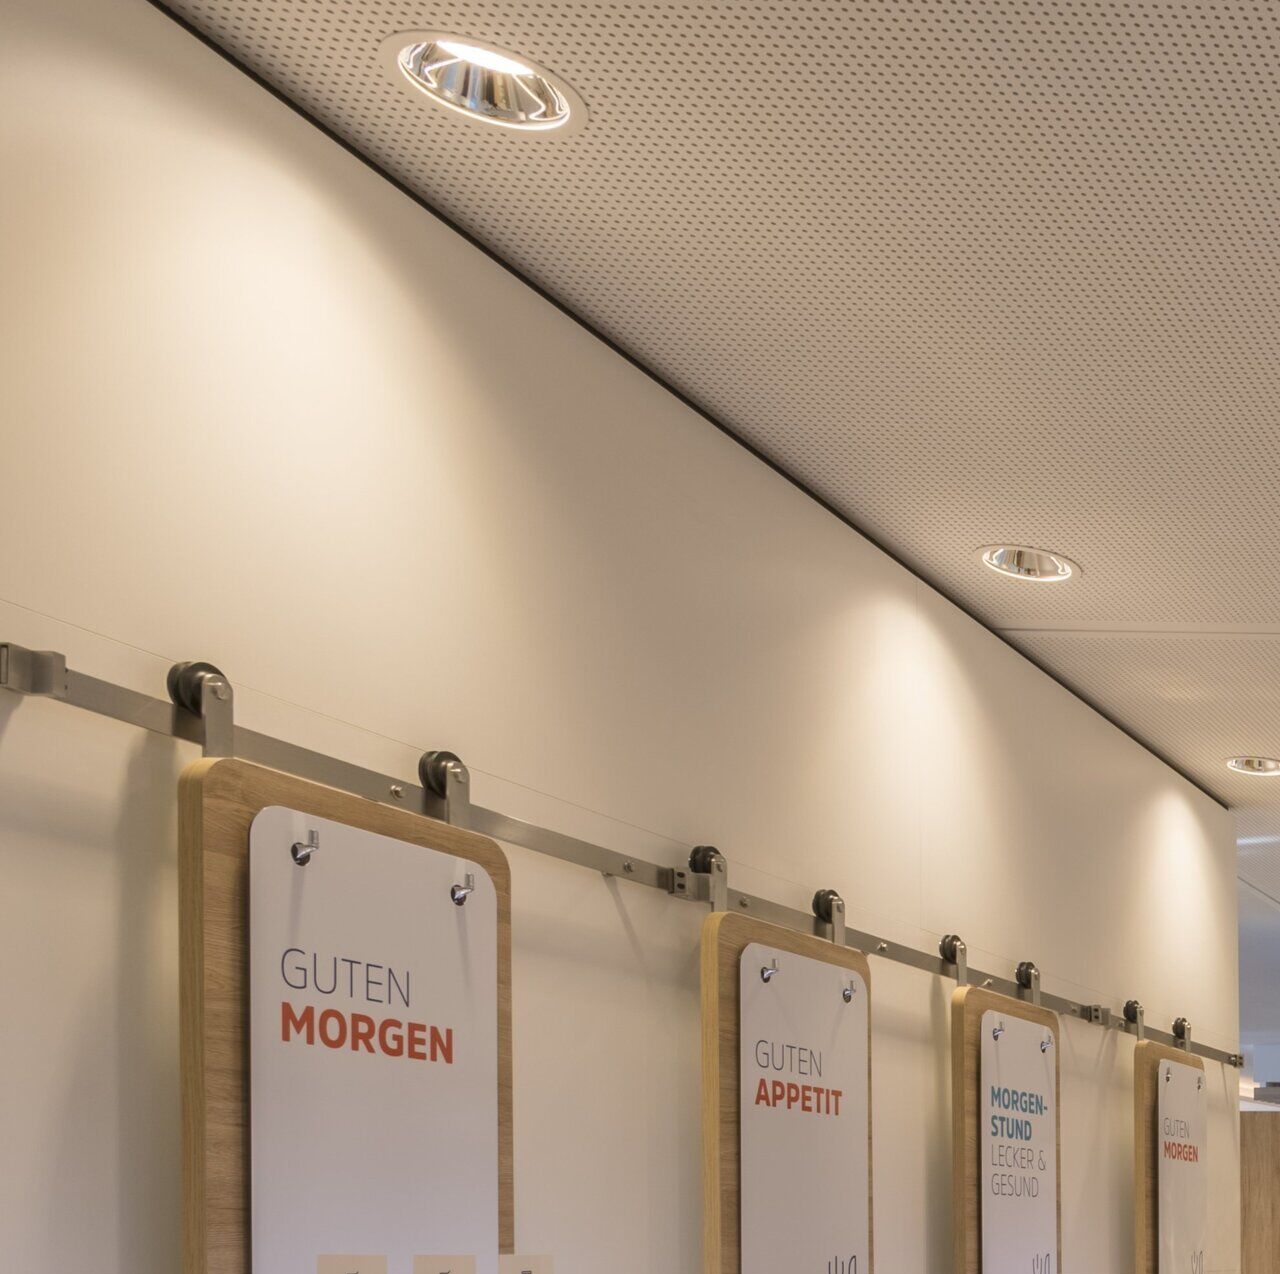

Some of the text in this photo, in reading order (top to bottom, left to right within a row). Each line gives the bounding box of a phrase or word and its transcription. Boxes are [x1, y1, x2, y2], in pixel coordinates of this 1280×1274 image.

[280, 947, 410, 1008] GUTEN
[281, 1001, 454, 1065] MORGEN
[755, 1039, 823, 1078] GUTEN
[754, 1077, 843, 1117] APPETIT
[990, 1085, 1048, 1116] MORGEN-
[990, 1114, 1032, 1141] STUND
[1163, 1116, 1191, 1140] GUTEN
[990, 1143, 1047, 1172] LECKER &
[1163, 1140, 1199, 1163] MORGEN
[990, 1172, 1040, 1199] GESUND
